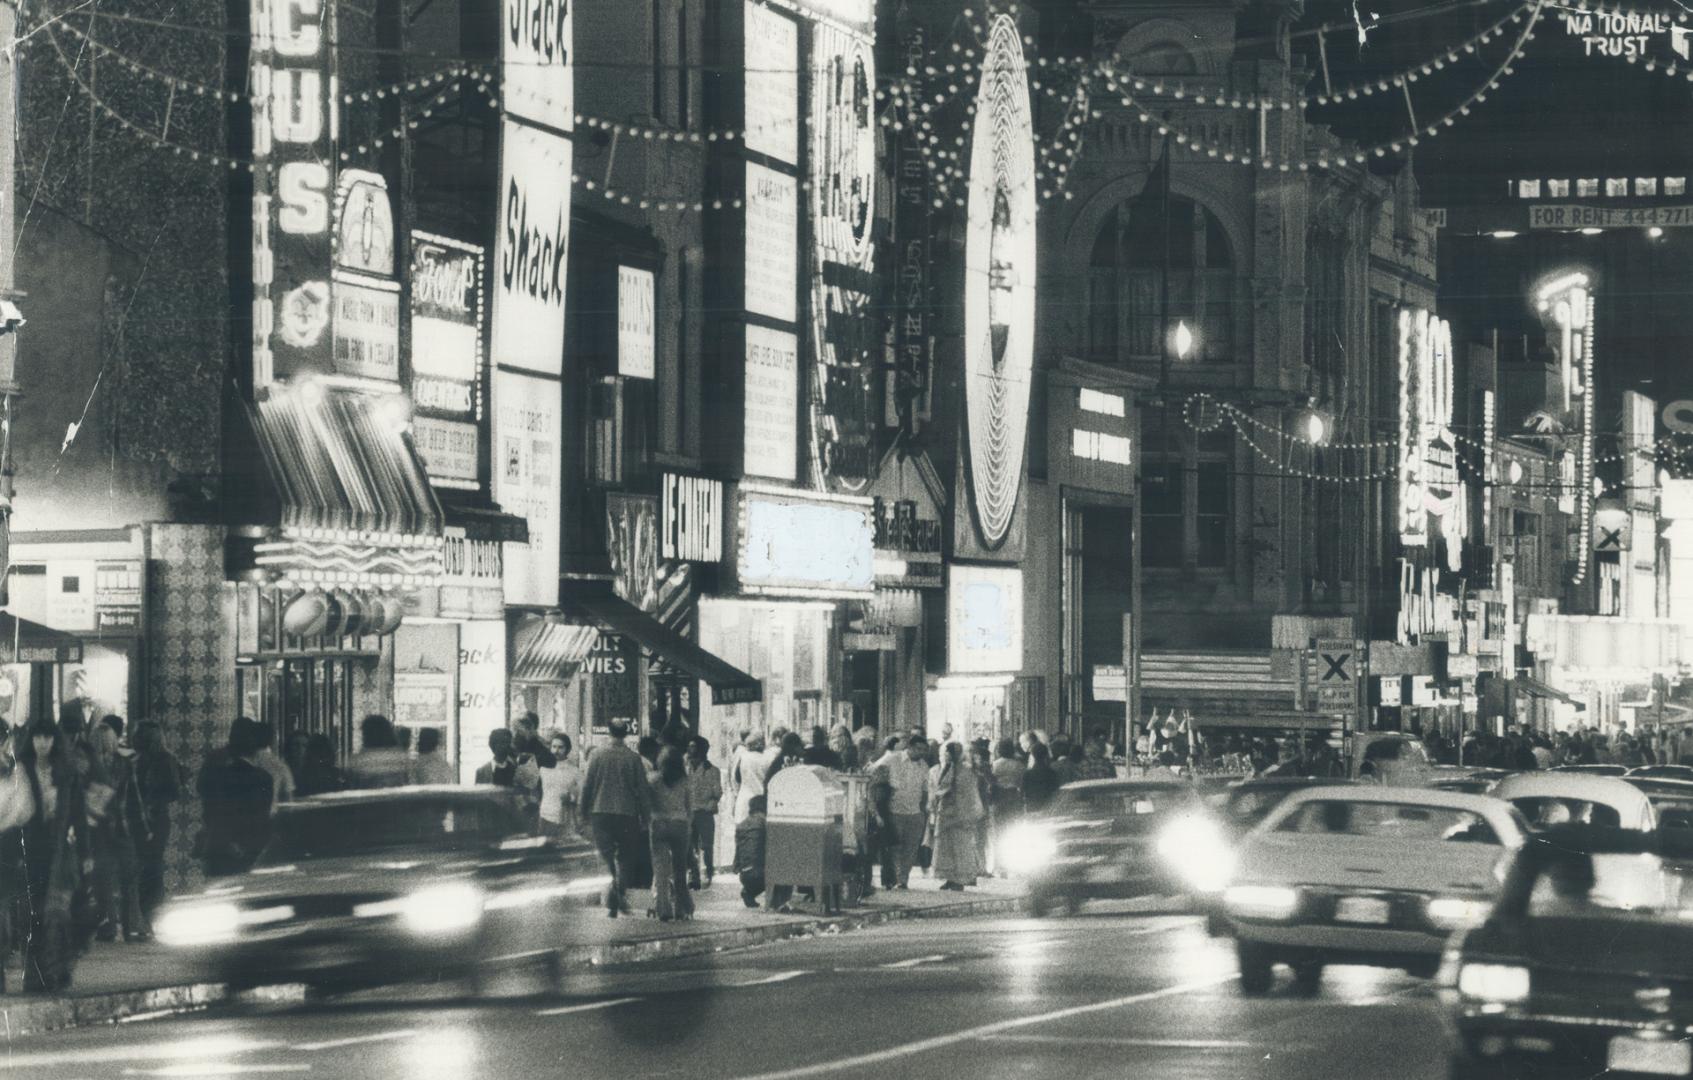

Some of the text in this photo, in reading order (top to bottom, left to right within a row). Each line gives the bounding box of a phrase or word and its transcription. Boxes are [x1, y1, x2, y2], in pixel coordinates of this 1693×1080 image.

[1567, 13, 1666, 35] NATIONAL
[1582, 36, 1649, 56] TRUST
[1534, 207, 1693, 225] FOR RENT 444-771
[504, 175, 566, 308] Shack
[443, 536, 465, 576] ORD
[470, 540, 503, 579] DRUGS
[458, 642, 498, 665] ack
[592, 635, 621, 652] ULT
[460, 687, 502, 709] ack
